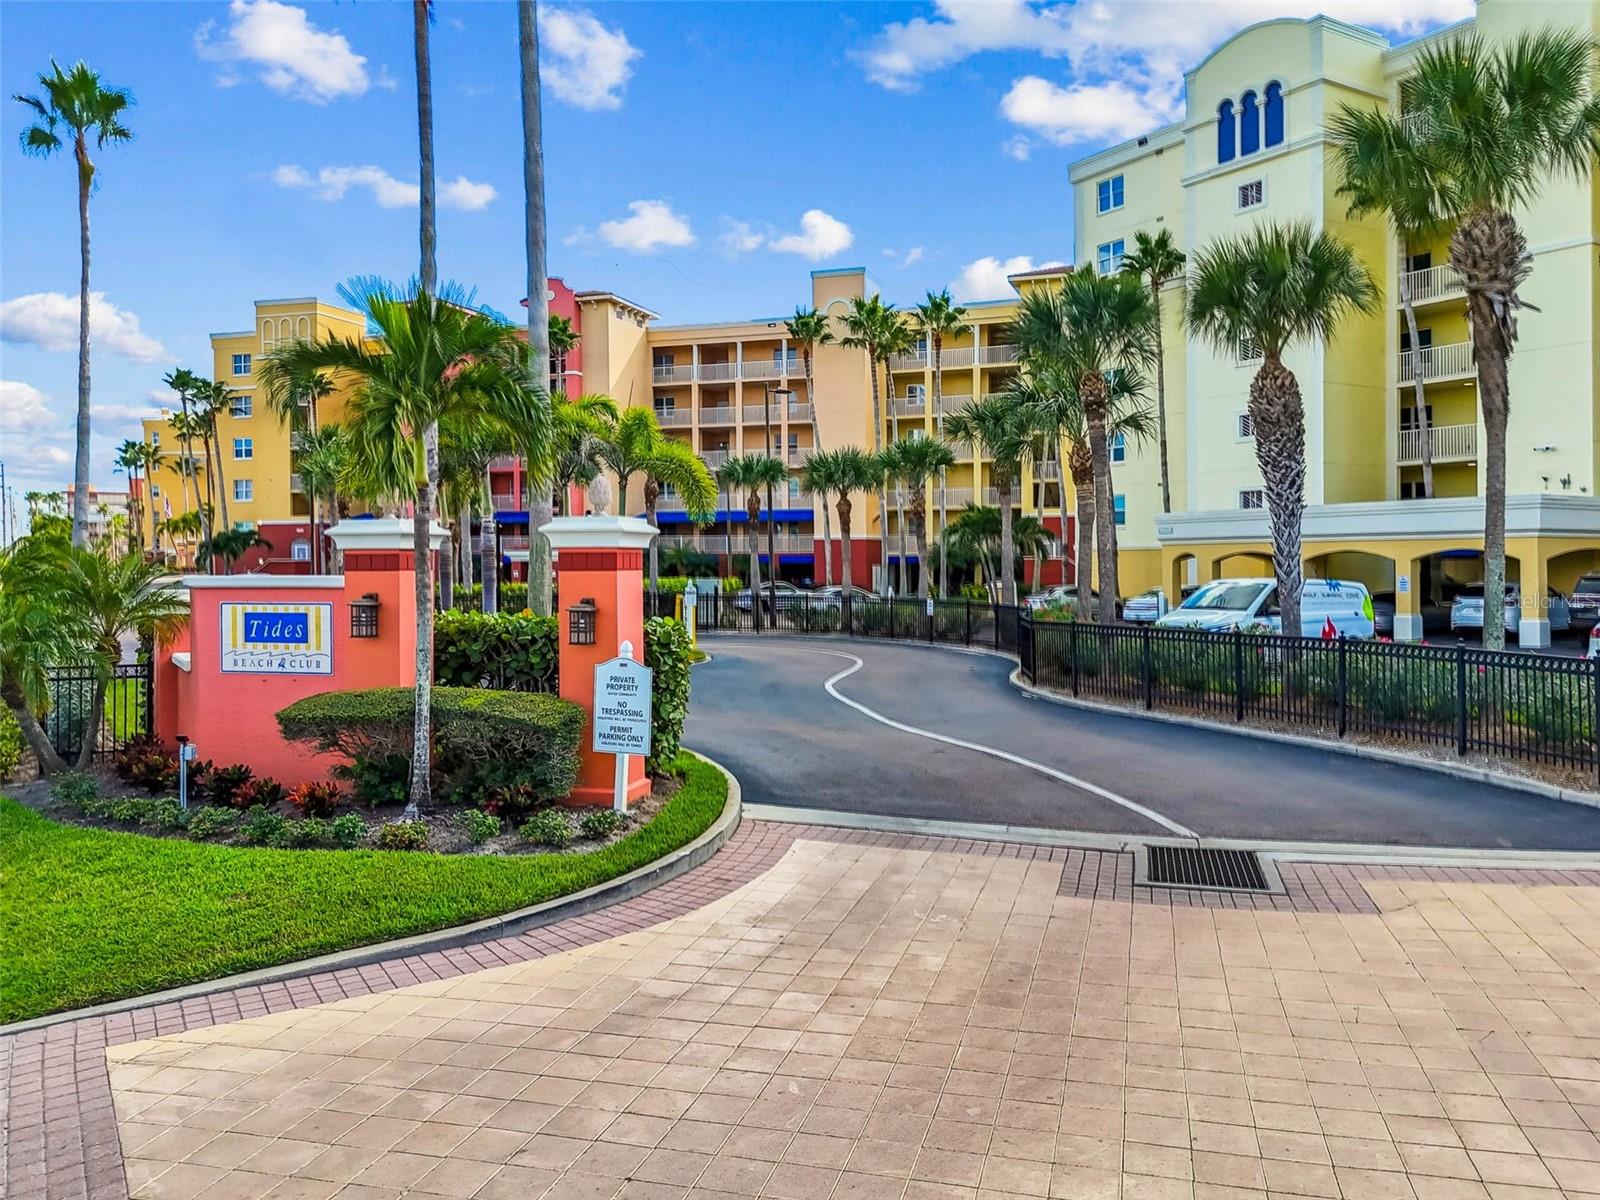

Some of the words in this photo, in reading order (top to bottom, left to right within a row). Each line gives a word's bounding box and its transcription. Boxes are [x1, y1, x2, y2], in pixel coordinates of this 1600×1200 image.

[250, 620, 304, 638] Tides
[233, 658, 273, 667] BEACH
[289, 659, 321, 669] CLUB
[609, 675, 636, 684] PRIVATE
[606, 683, 640, 692] PROPERTY
[617, 701, 628, 709] NO
[601, 707, 644, 718] TRESPASSING
[609, 725, 633, 734] PERMIT
[598, 732, 626, 742] PARKING
[626, 734, 644, 742] ONLY
